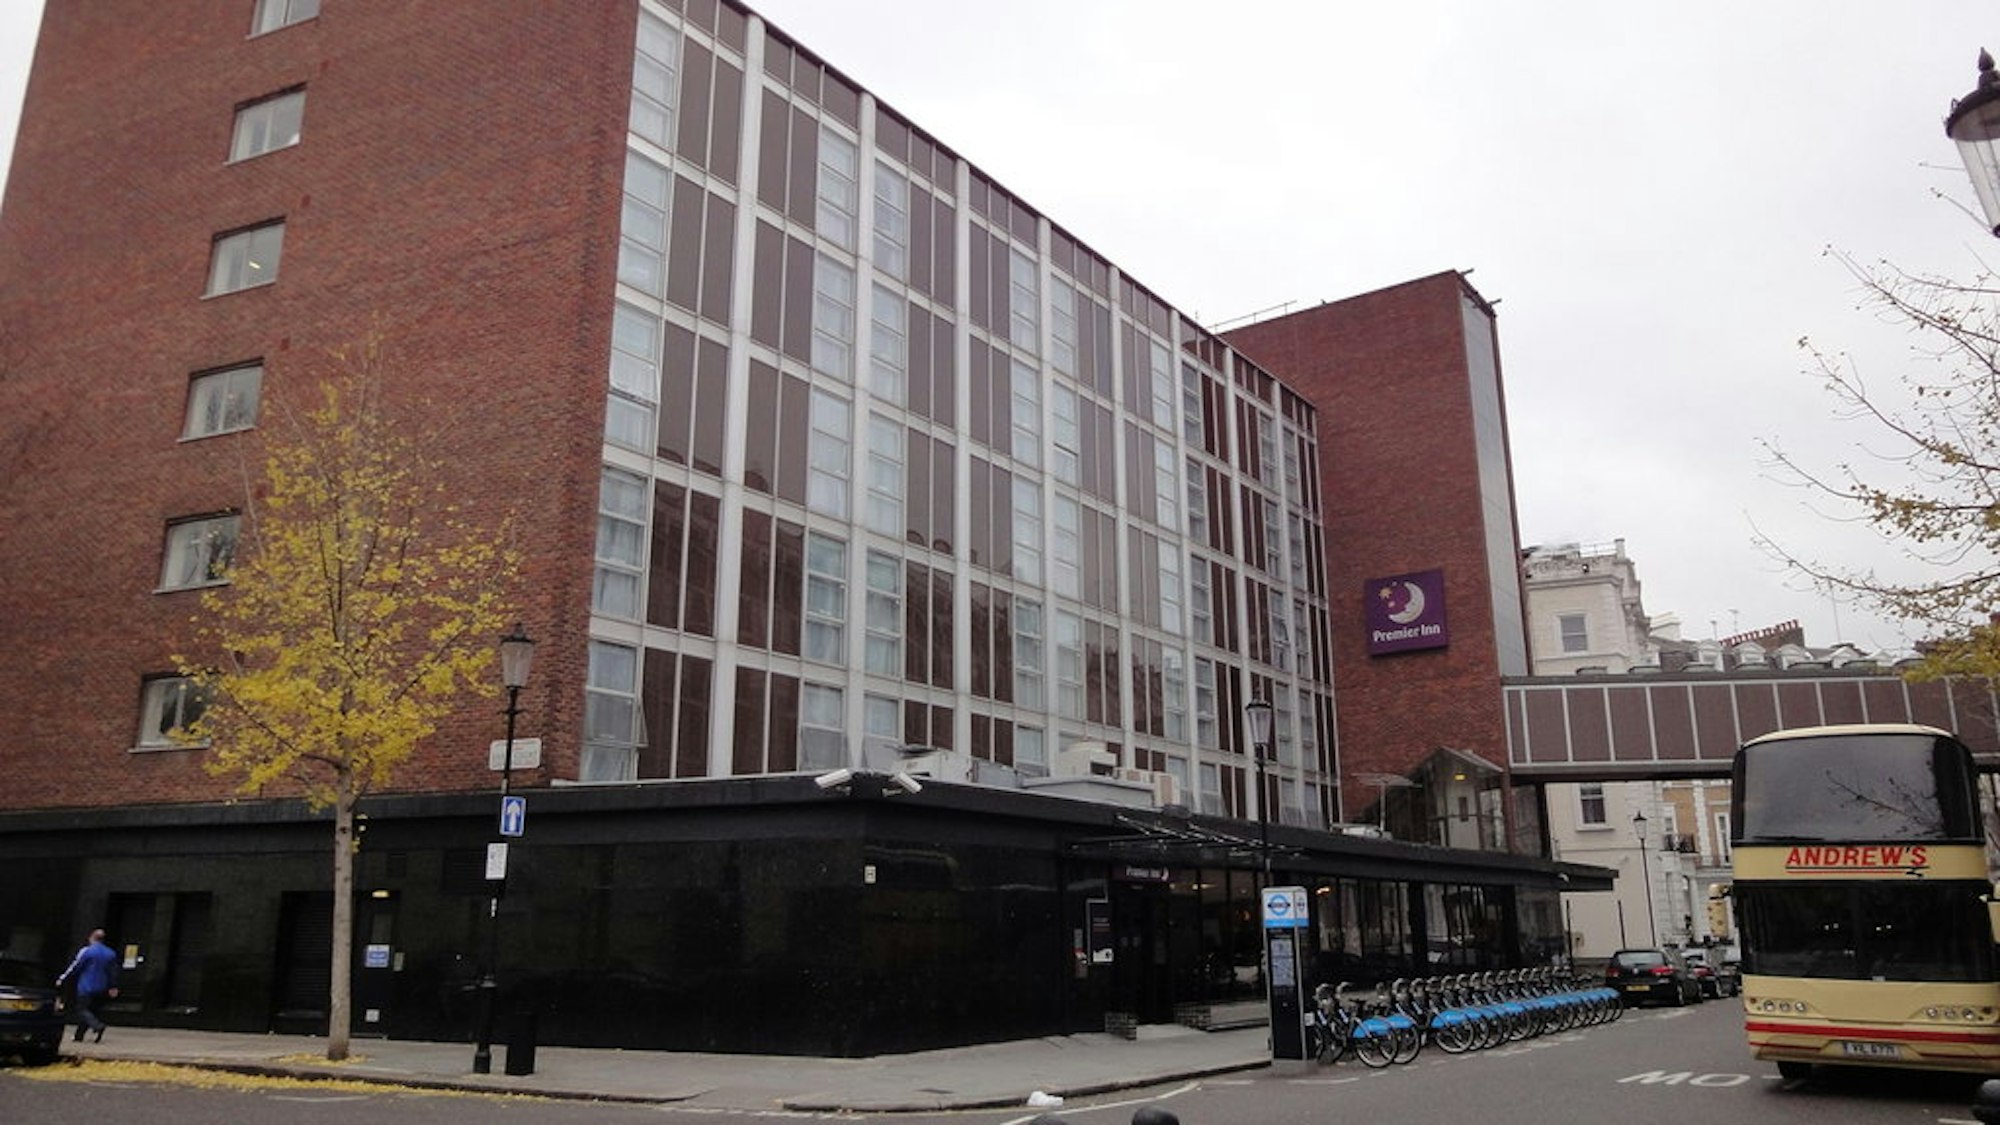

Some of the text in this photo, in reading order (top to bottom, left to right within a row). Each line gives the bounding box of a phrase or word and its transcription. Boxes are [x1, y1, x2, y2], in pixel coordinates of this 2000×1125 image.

[1372, 623, 1441, 642] Premier Inn
[1786, 846, 1927, 867] ANDREW'S
